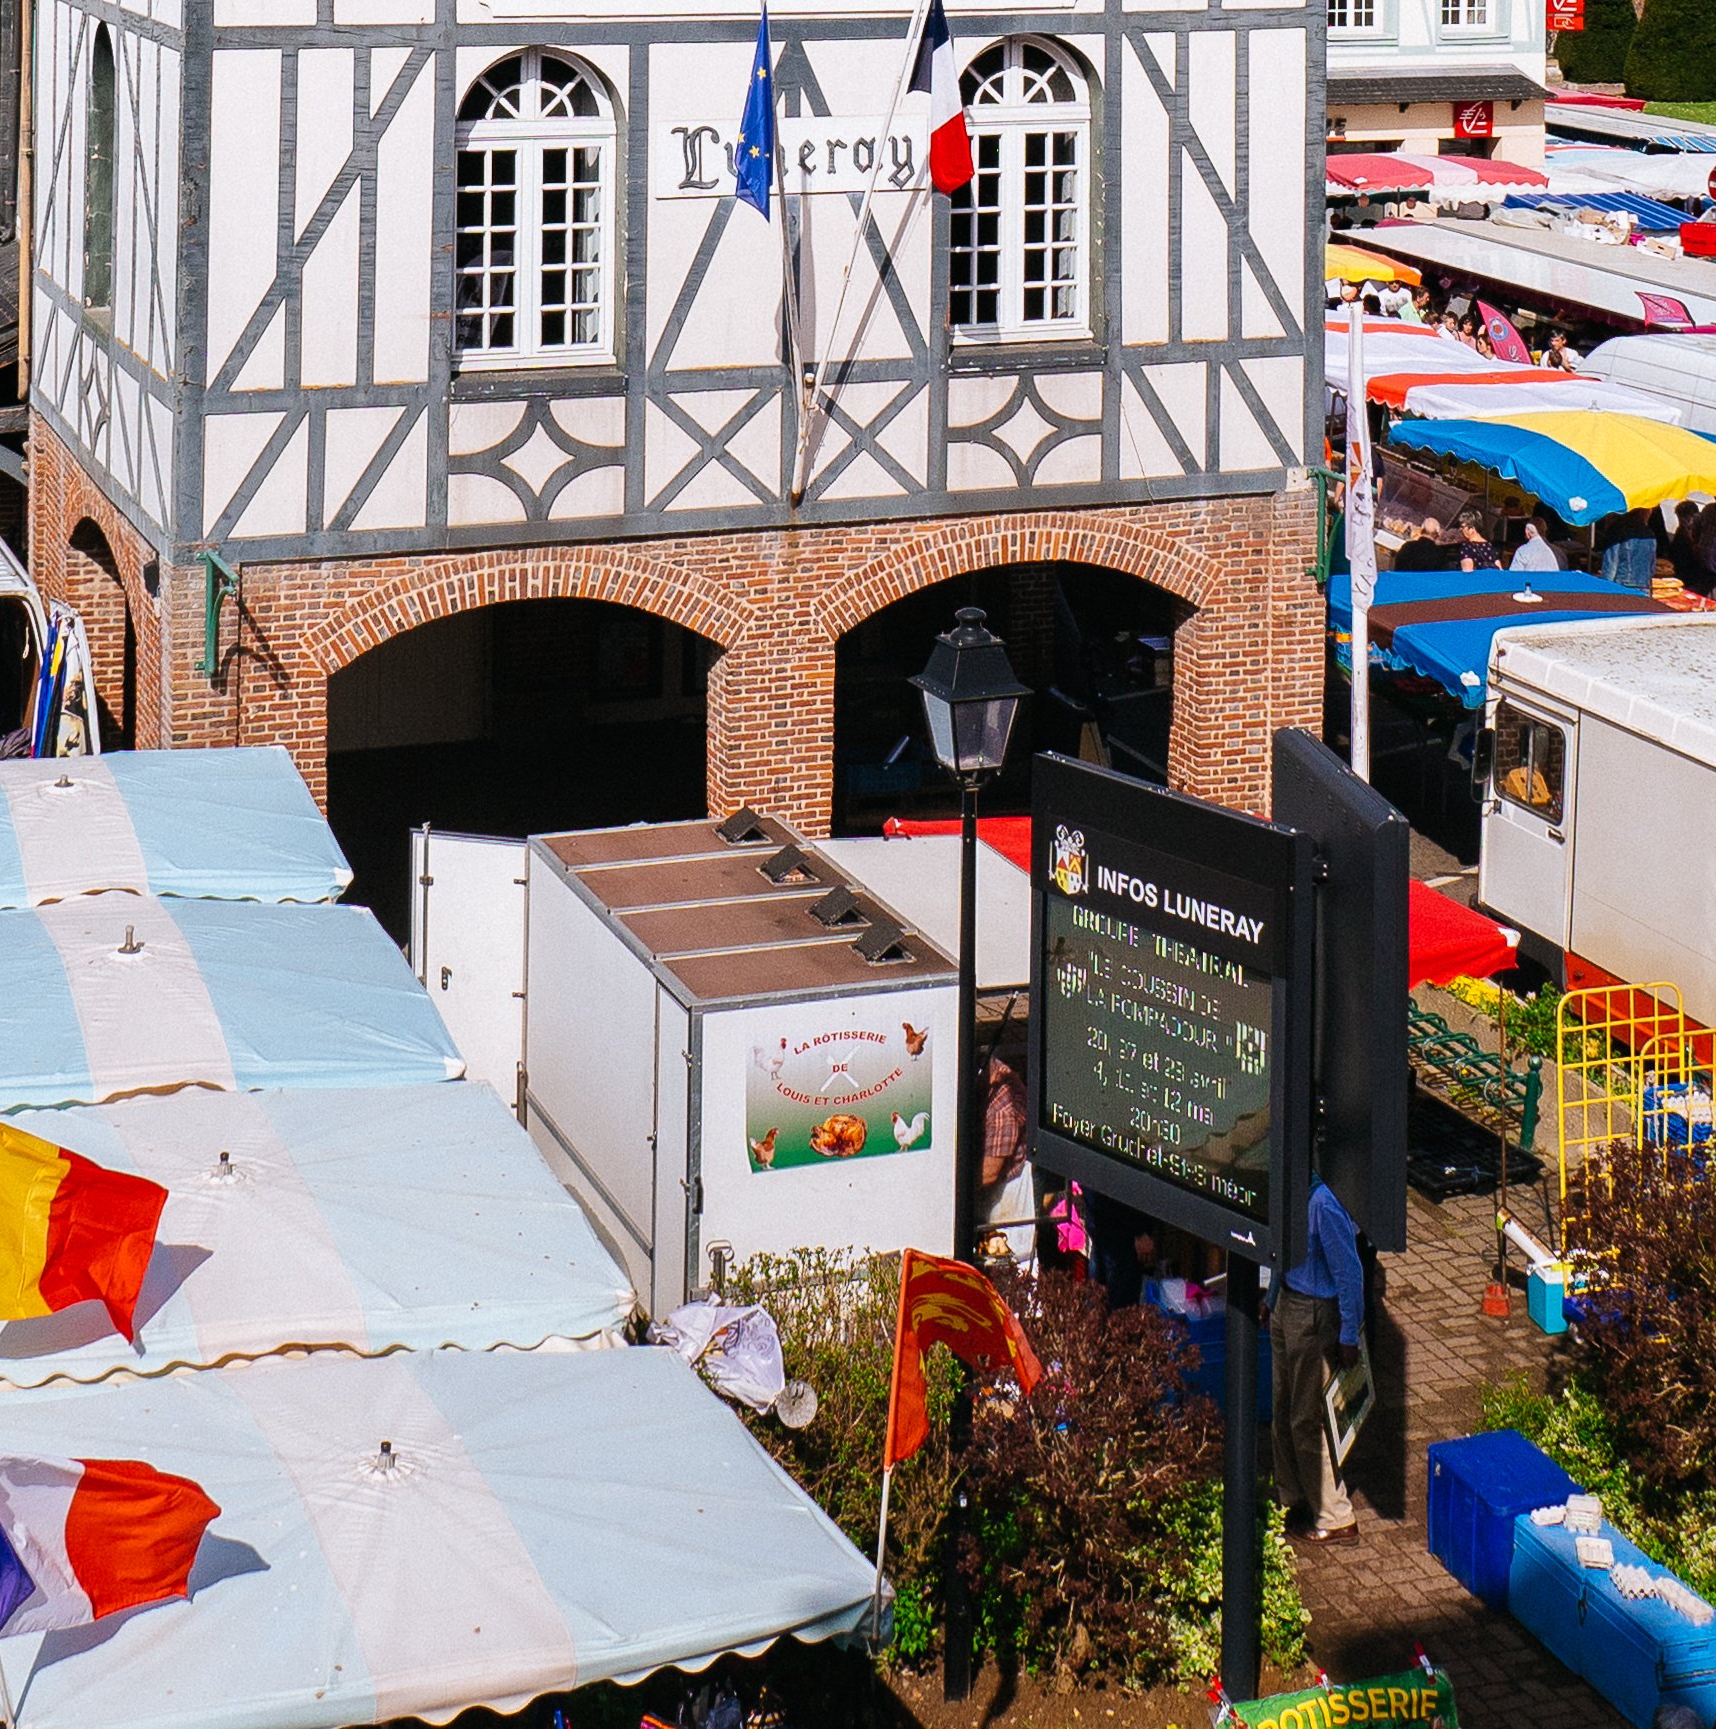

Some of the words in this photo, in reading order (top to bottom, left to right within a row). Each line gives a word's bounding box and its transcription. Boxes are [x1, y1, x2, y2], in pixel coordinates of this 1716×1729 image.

[1097, 865, 1158, 908] INFOS
[1163, 888, 1265, 945] LUNERAY
[793, 1041, 811, 1055] LA
[813, 1030, 888, 1046] RÔTISSERIE
[776, 1082, 811, 1105] LOUIS
[814, 1096, 830, 1106] ET
[833, 1067, 904, 1106] CHARLOTTE
[832, 1063, 849, 1073] DE
[1258, 1687, 1439, 1729] OTISSERIE
